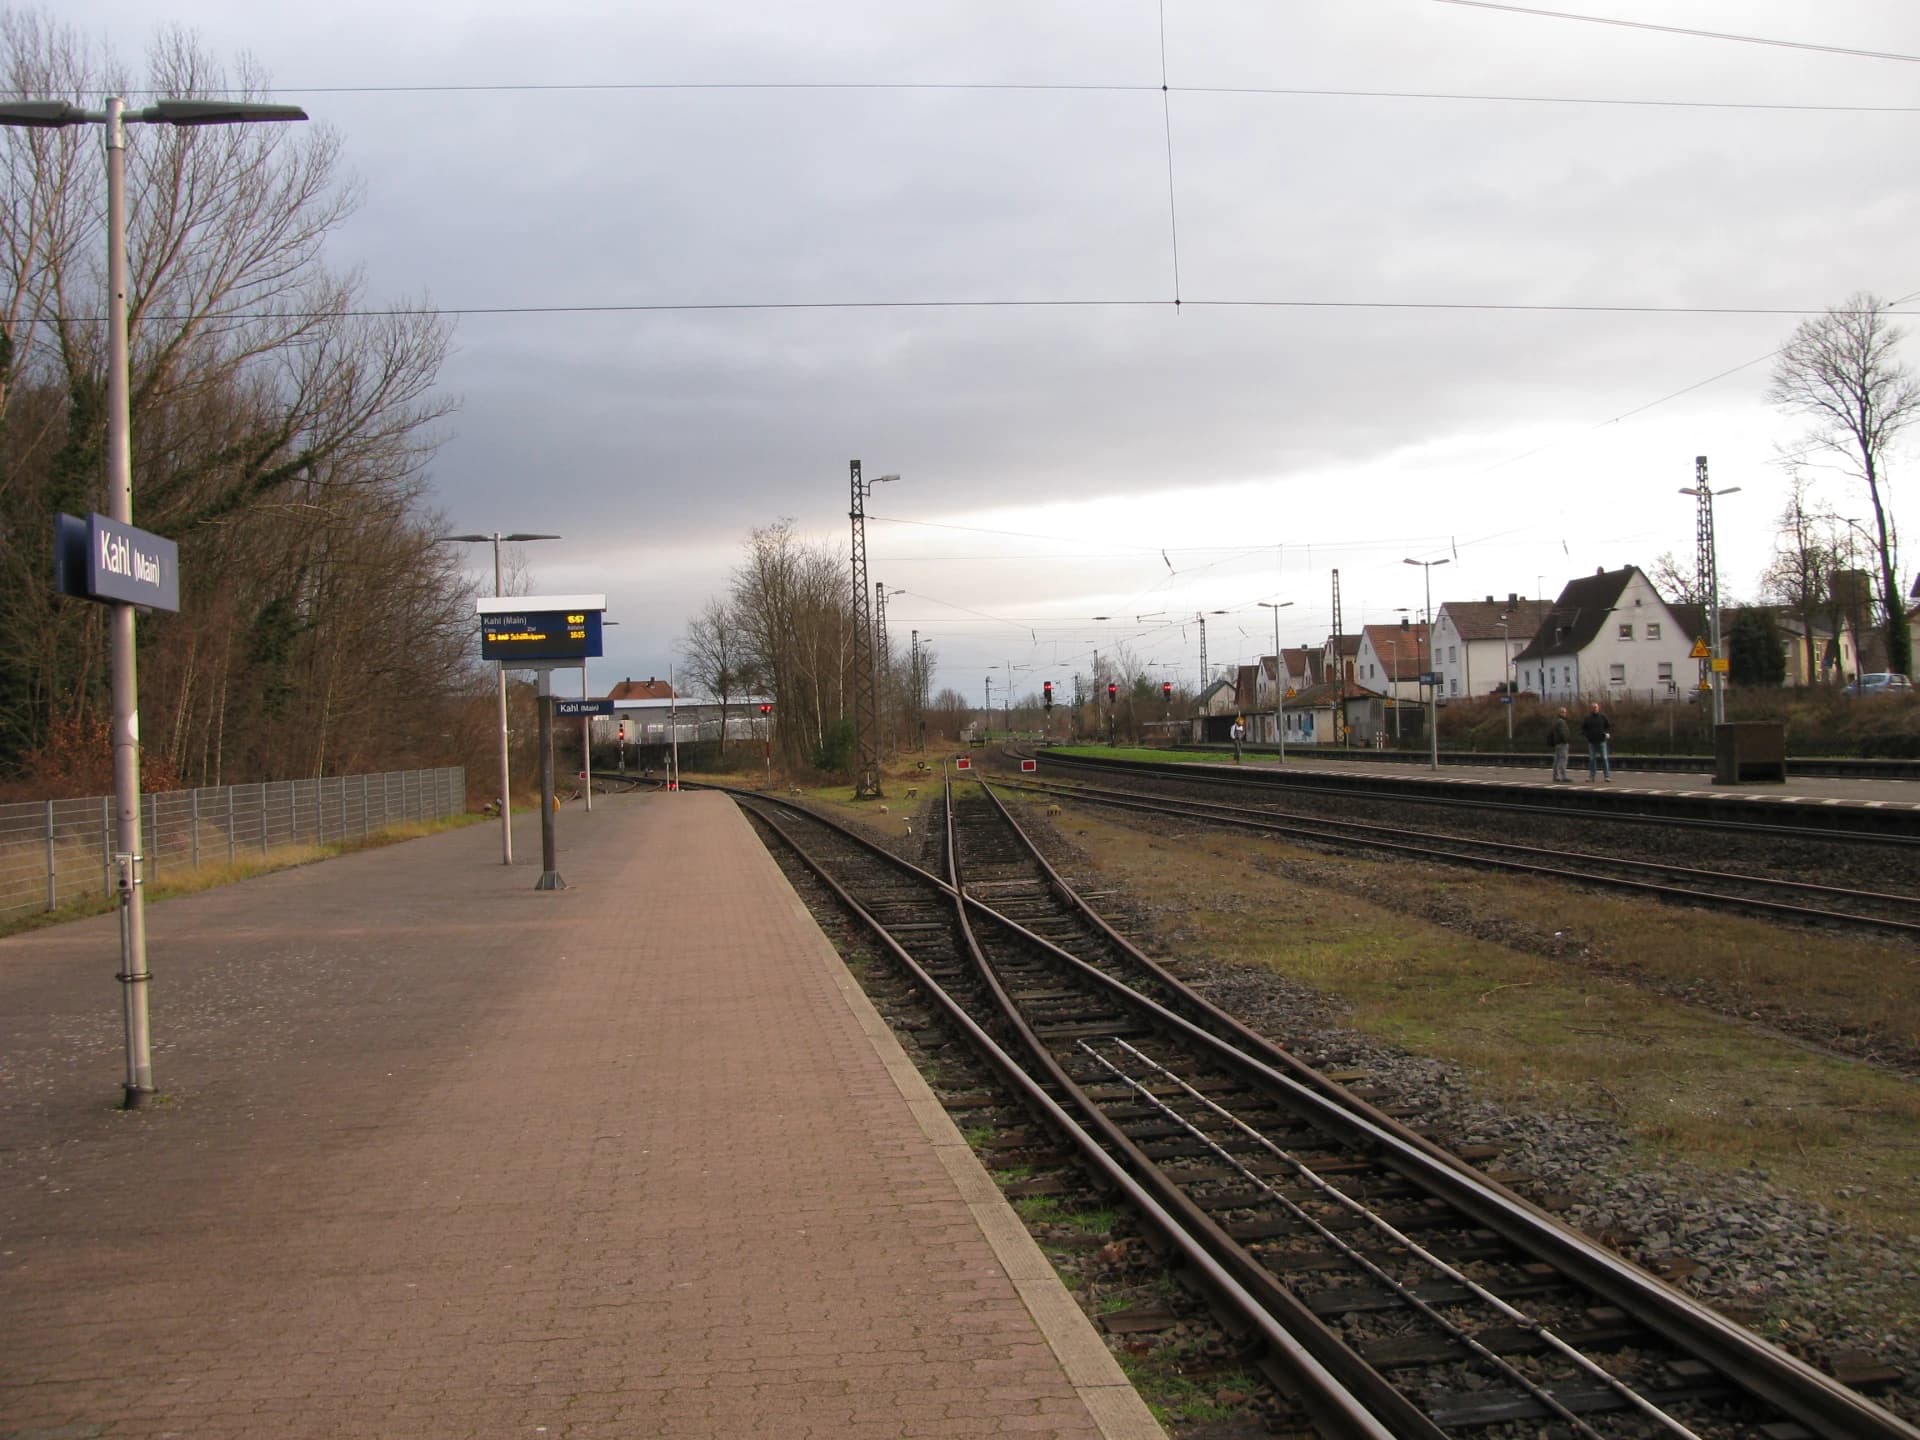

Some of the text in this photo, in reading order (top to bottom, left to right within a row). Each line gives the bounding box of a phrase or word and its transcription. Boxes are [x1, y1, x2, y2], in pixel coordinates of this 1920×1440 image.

[101, 529, 160, 588] Kahl (Main)
[484, 616, 501, 625] Kahl
[560, 703, 600, 713] Kahl (Main)
